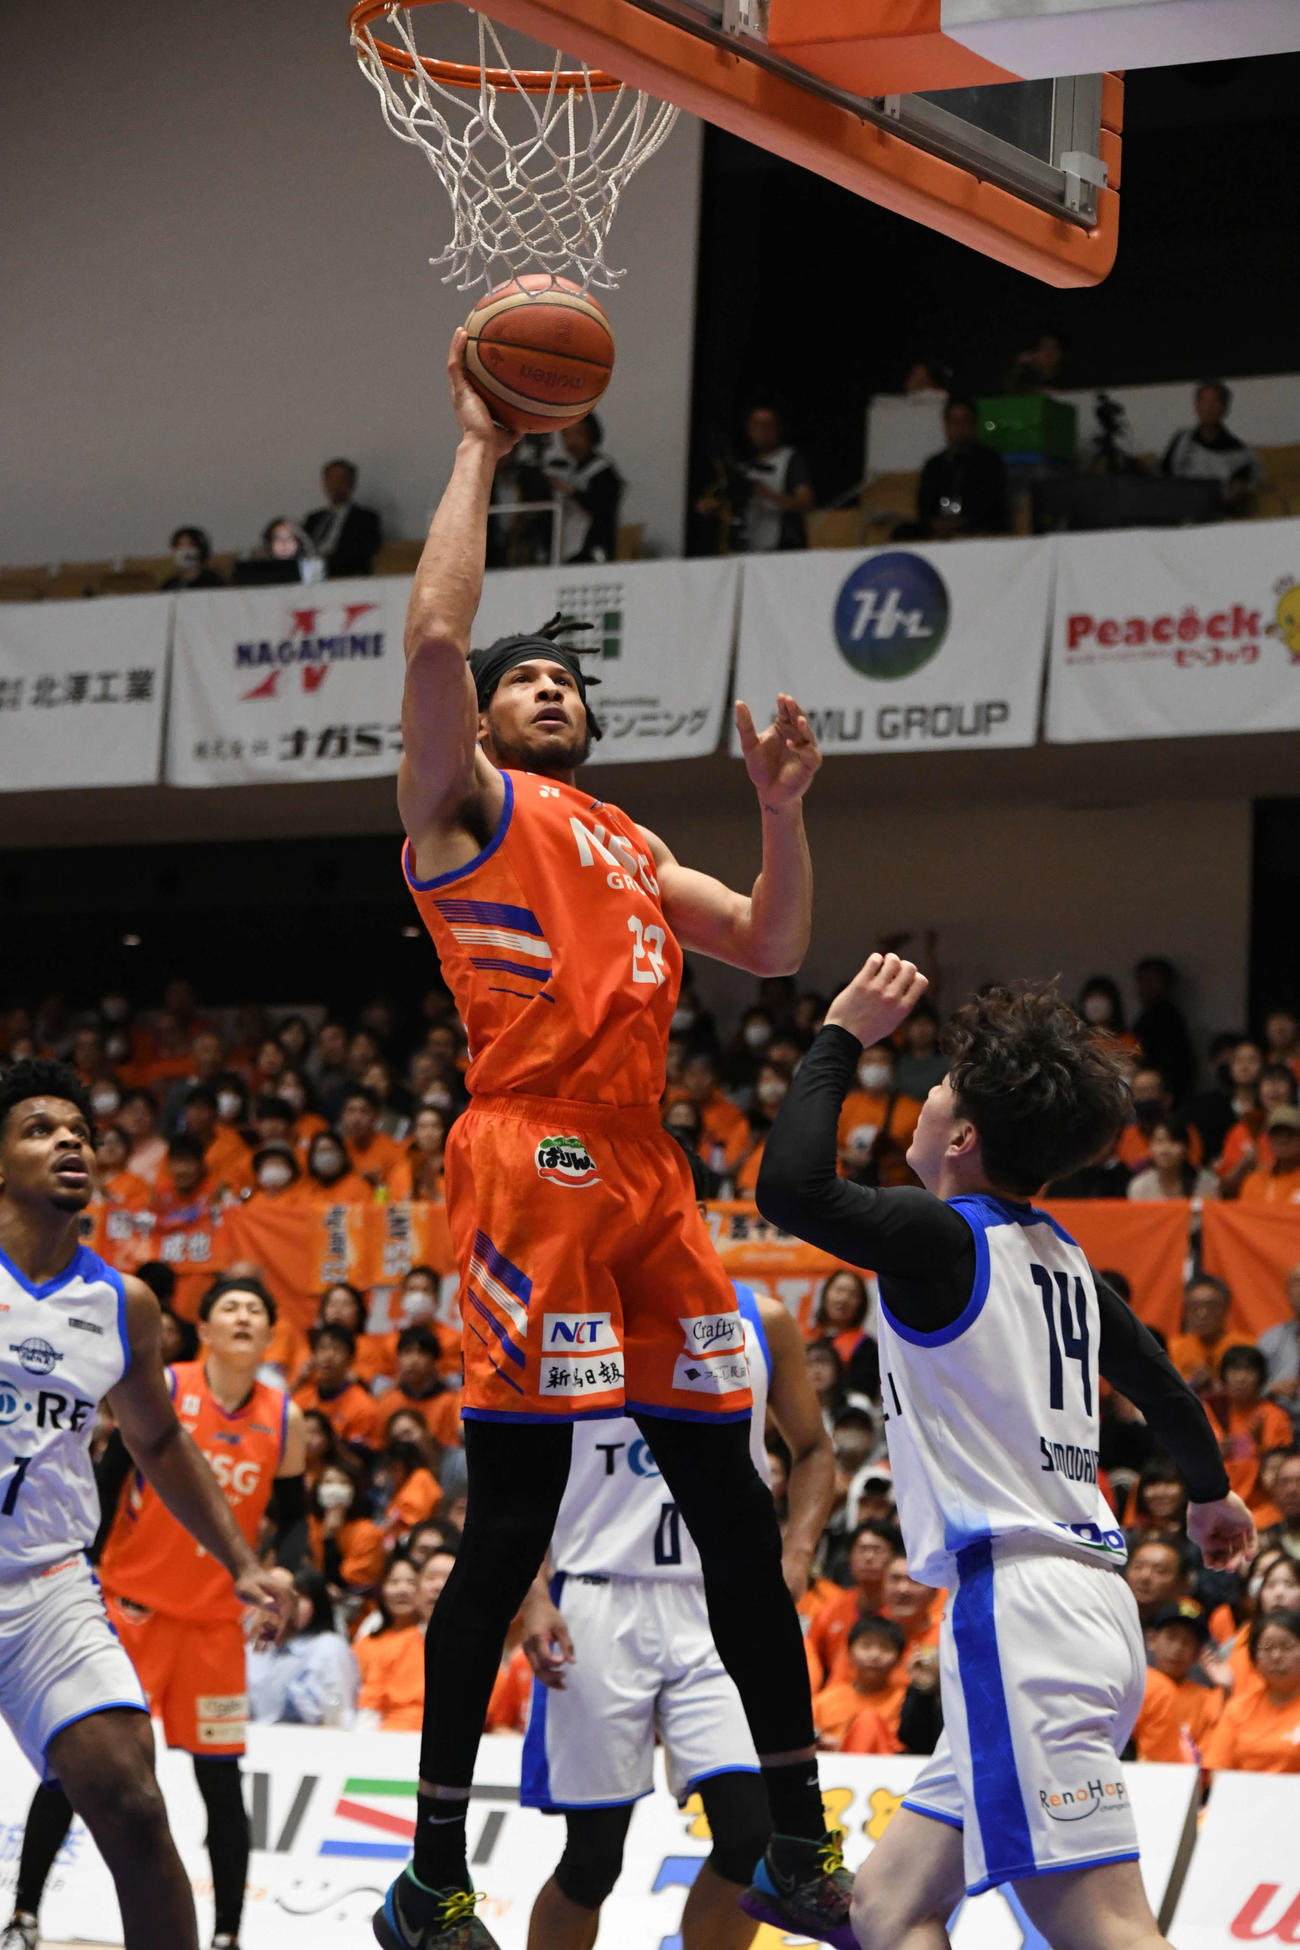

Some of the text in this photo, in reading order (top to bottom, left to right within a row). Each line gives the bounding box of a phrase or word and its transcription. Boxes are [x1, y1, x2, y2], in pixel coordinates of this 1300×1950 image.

[1067, 603, 1260, 650] Peacock
[235, 632, 386, 669] NAGAMINE
[877, 701, 1009, 741] GROUP
[569, 817, 660, 896] NSG
[693, 1318, 735, 1342] Crafty
[1031, 1263, 1092, 1417] 14
[1, 1456, 32, 1517] 7
[202, 1451, 261, 1495] SG
[654, 1502, 682, 1566] 0
[1039, 1779, 1127, 1809] RenoHap
